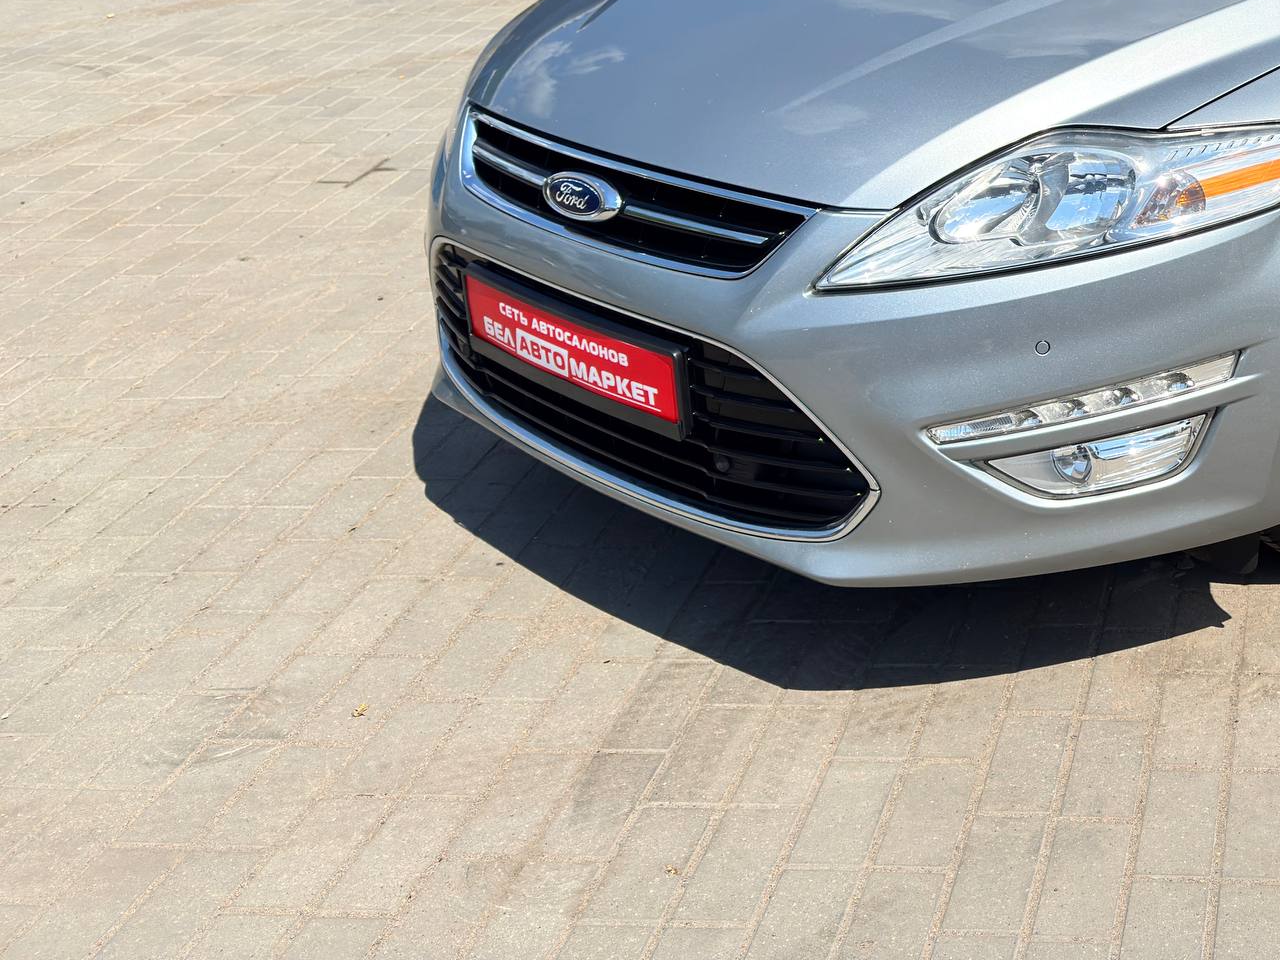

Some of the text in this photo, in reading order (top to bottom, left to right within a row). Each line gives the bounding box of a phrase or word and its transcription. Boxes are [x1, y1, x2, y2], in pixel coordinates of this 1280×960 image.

[555, 182, 590, 210] Ford
[483, 316, 659, 407] БЕЛ АВТО МАРКЕТ
[499, 302, 629, 367] СЕТЬ АВТОСАЛОНОВ
